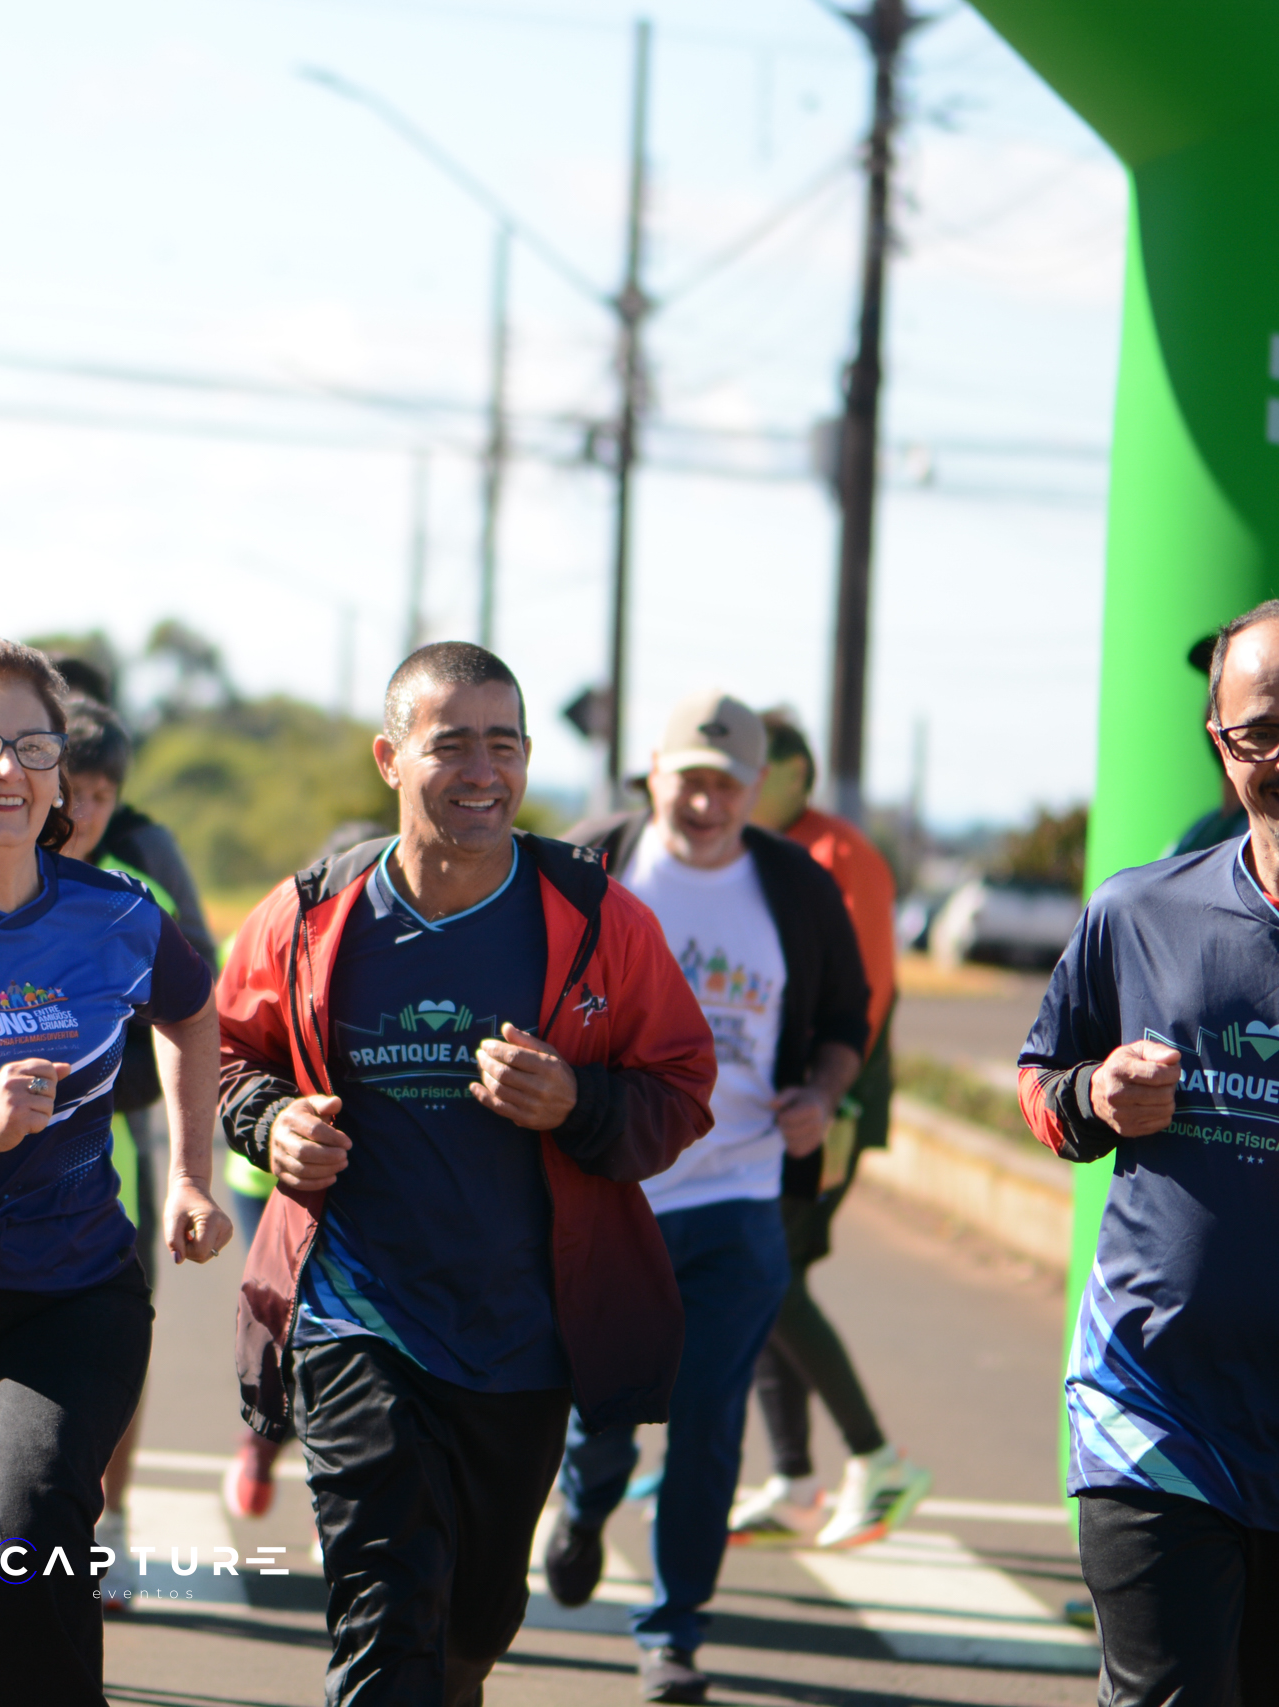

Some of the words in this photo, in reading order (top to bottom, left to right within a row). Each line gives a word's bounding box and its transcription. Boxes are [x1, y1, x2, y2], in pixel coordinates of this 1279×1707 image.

[33, 1004, 61, 1017] ENTRE
[349, 1043, 452, 1067] PRATIQUE
[421, 1085, 462, 1099] FÍSICA
[1176, 1068, 1279, 1104] RATIQUE
[1161, 1121, 1233, 1145] DUCAÇÃO
